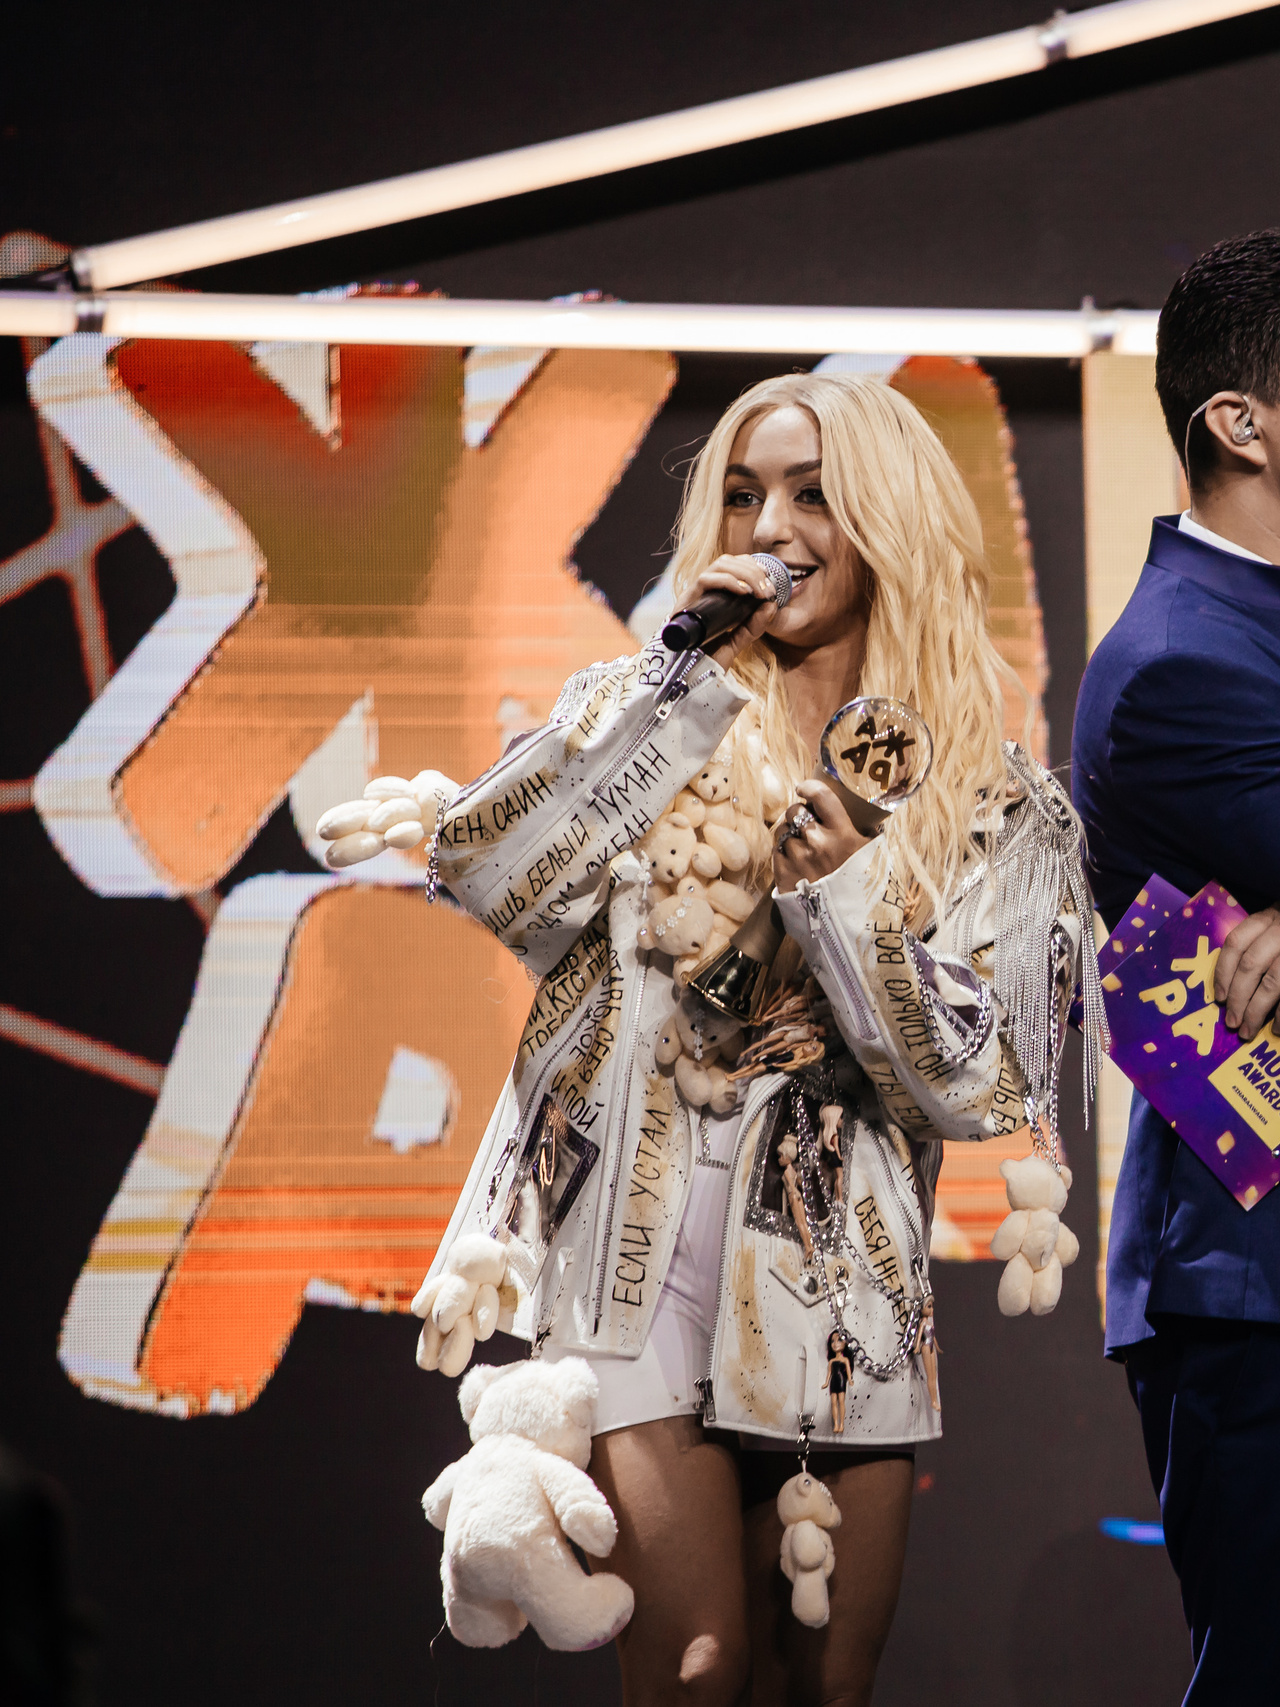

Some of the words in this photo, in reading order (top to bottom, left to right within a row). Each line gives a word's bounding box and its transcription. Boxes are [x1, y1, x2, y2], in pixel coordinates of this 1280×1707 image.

[492, 772, 554, 832] ОДИН
[527, 813, 591, 898] БЕЛЫЙ
[586, 741, 671, 824] ТУМАН
[545, 969, 587, 1014] КТО
[884, 978, 933, 1052] ТОЛЬКО
[914, 1052, 955, 1083] НО
[562, 1083, 605, 1134] ПОЙ
[627, 1107, 672, 1202] УСТАЛ
[853, 1194, 891, 1257] СЕБЯ
[611, 1222, 655, 1308] ЕСЛИ
